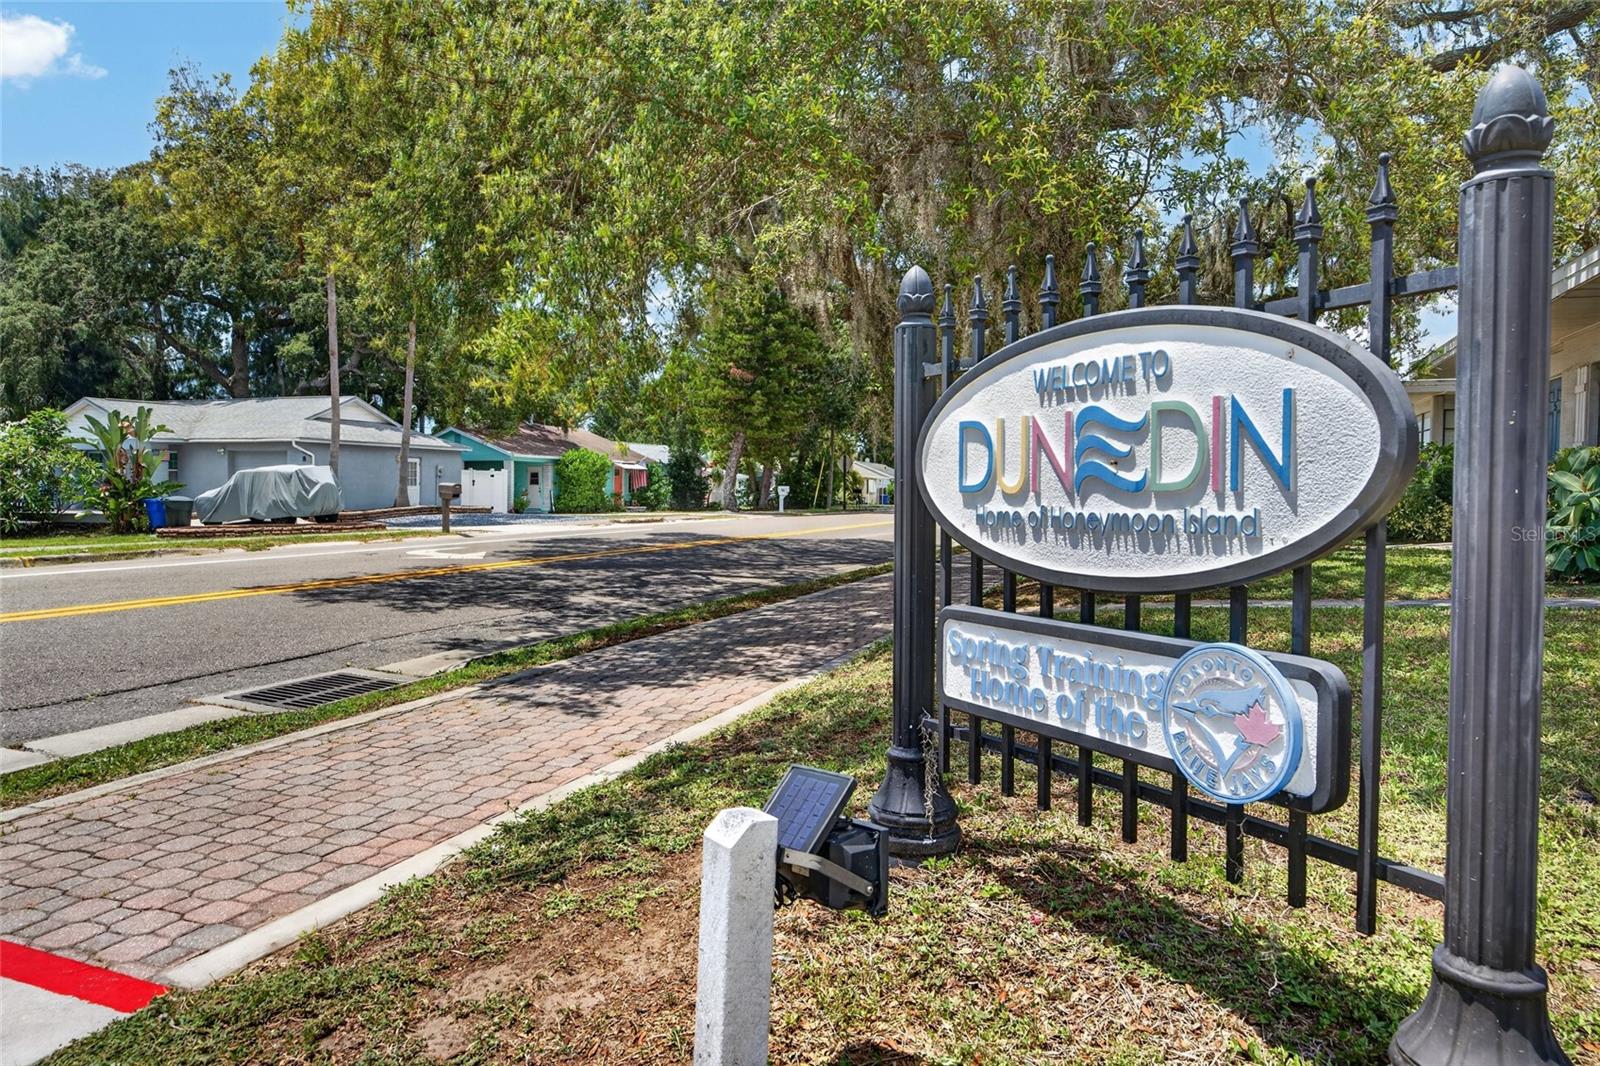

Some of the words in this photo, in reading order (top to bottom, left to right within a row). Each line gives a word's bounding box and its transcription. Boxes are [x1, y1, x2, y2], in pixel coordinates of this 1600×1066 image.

[1033, 355, 1136, 394] WELCOME
[1138, 349, 1169, 379] TO
[958, 388, 1294, 497] DUNEDIN
[975, 504, 1022, 528] Home
[1027, 505, 1048, 529] of
[1050, 505, 1175, 537] Honeymoon
[1183, 507, 1258, 537] Island
[948, 629, 1028, 680] Spring
[1036, 645, 1165, 712] Training
[970, 667, 1046, 713] Home
[1056, 688, 1088, 722] of
[1095, 696, 1145, 739] the
[1173, 656, 1254, 697] TORONTO
[1173, 731, 1218, 789] BLUE
[1230, 754, 1276, 796] JAYS
